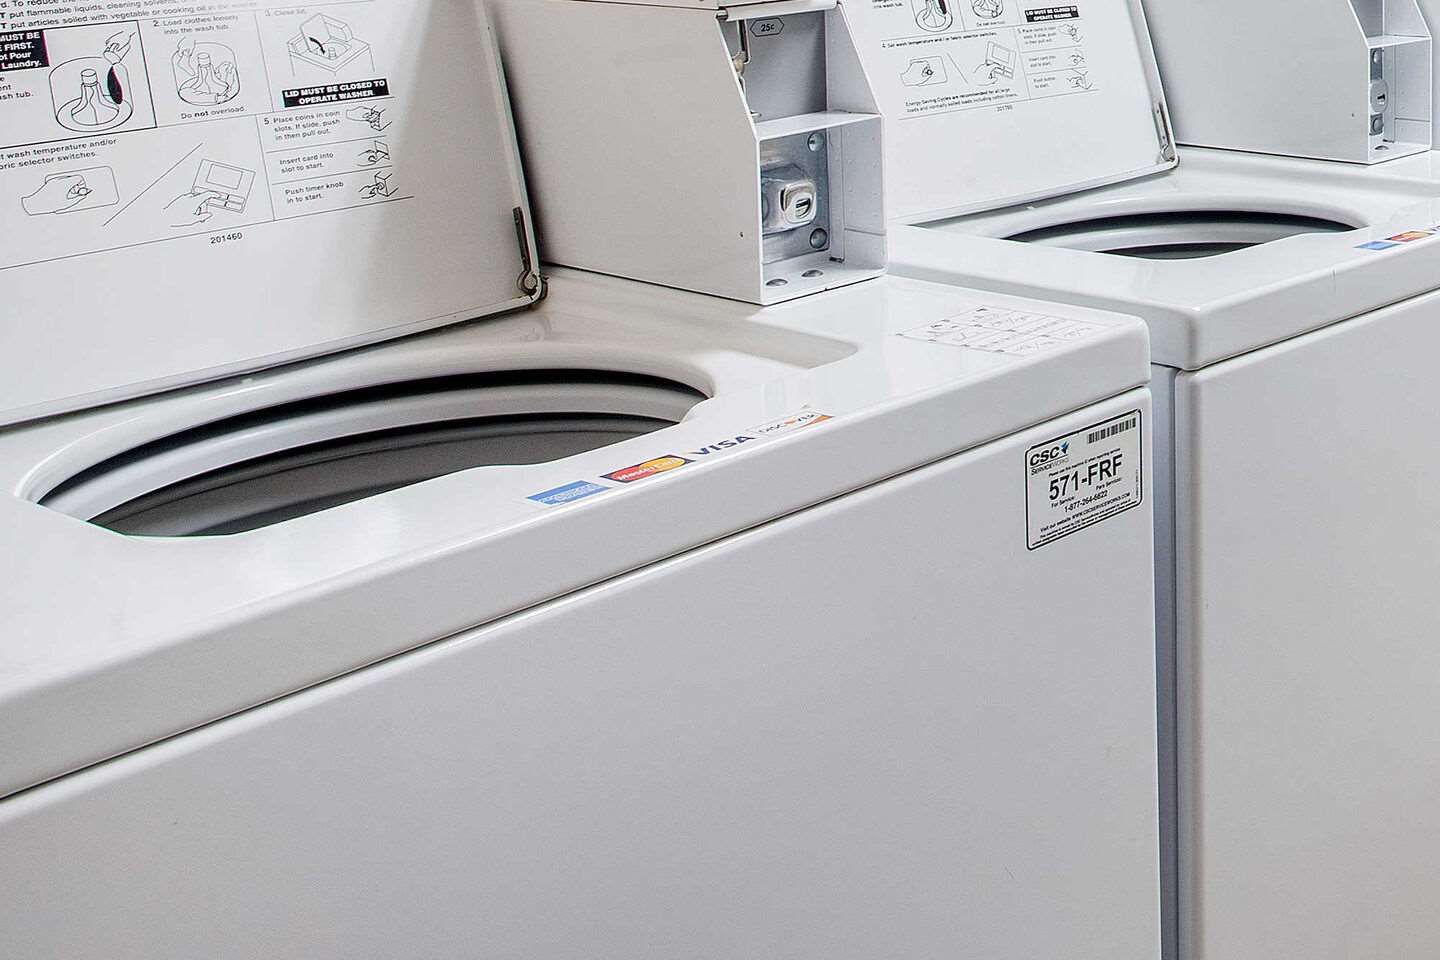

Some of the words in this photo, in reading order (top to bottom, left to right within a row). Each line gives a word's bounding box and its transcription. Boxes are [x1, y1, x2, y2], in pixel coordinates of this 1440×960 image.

[26, 31, 40, 40] BE
[4, 42, 35, 51] FIRST.
[9, 52, 31, 60] Pour
[284, 90, 299, 98] LID
[300, 88, 325, 96] MUST
[340, 81, 373, 91] CLOSED
[298, 95, 338, 105] OPERATE
[7, 150, 30, 159] wash
[33, 142, 86, 156] temperature
[18, 157, 54, 167] selector
[692, 435, 756, 455] VISA
[1030, 446, 1060, 466] CSC
[1049, 453, 1123, 501] 571-FRF
